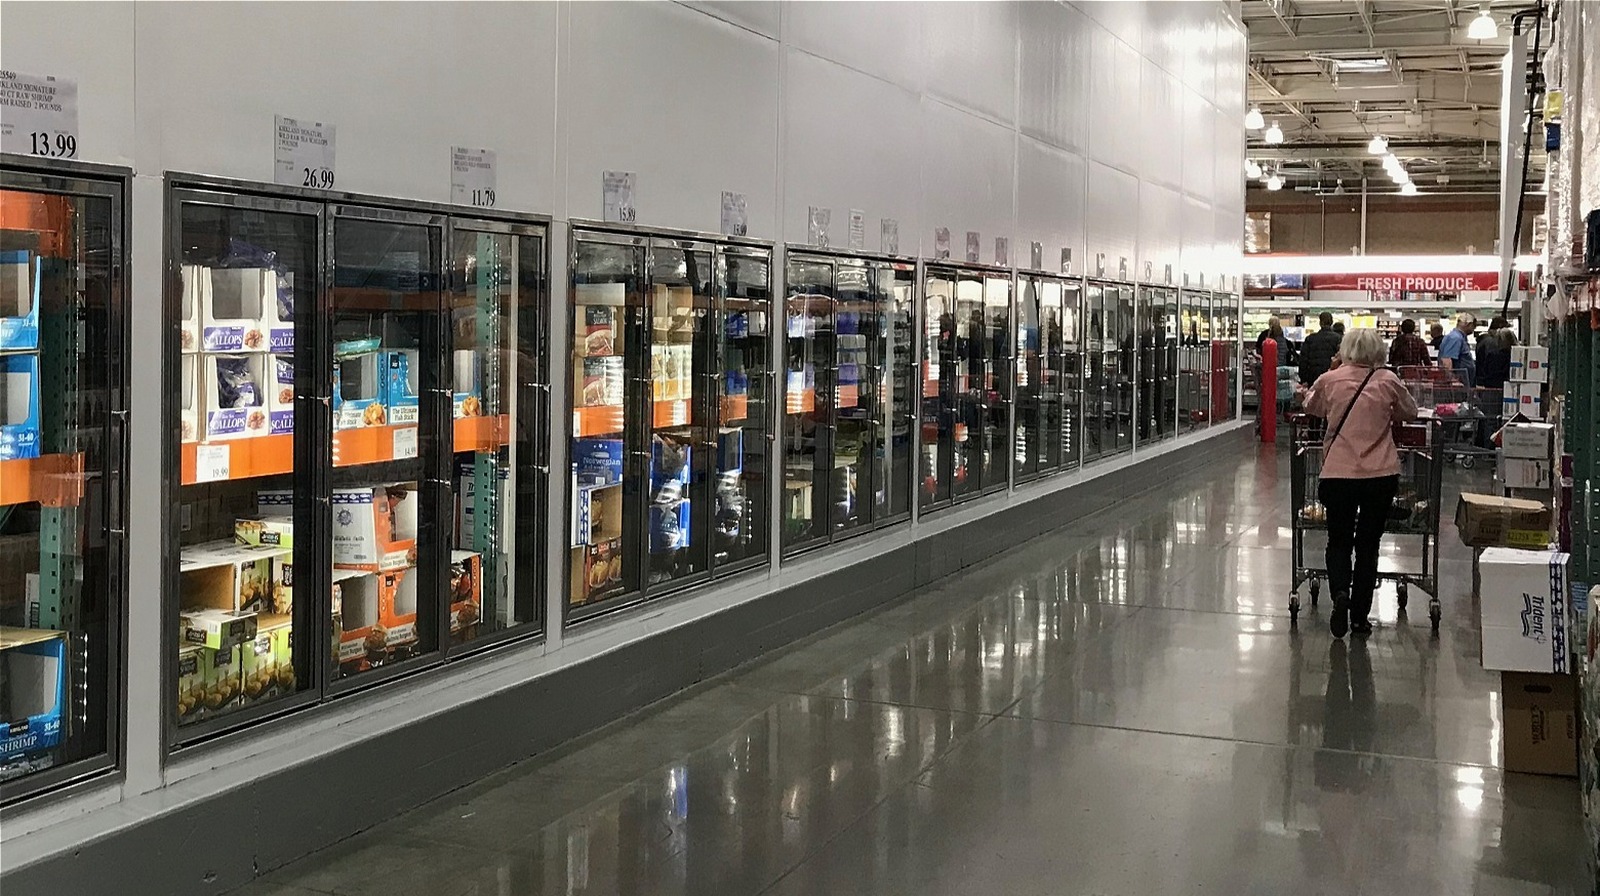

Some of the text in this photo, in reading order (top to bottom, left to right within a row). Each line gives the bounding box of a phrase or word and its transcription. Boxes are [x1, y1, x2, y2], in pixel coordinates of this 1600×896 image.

[0, 80, 56, 95] KLAND SIGNATURE
[31, 93, 53, 102] SHRIMP
[39, 102, 62, 112] POUNDS
[30, 131, 77, 158] 13.99
[303, 167, 334, 189] 26.99
[472, 189, 496, 207] 11.79
[1357, 277, 1474, 290] FRESH PRODUCE
[583, 457, 620, 465] Norwegian
[1532, 595, 1545, 635] Trident
[0, 735, 38, 752] SHRIMP
